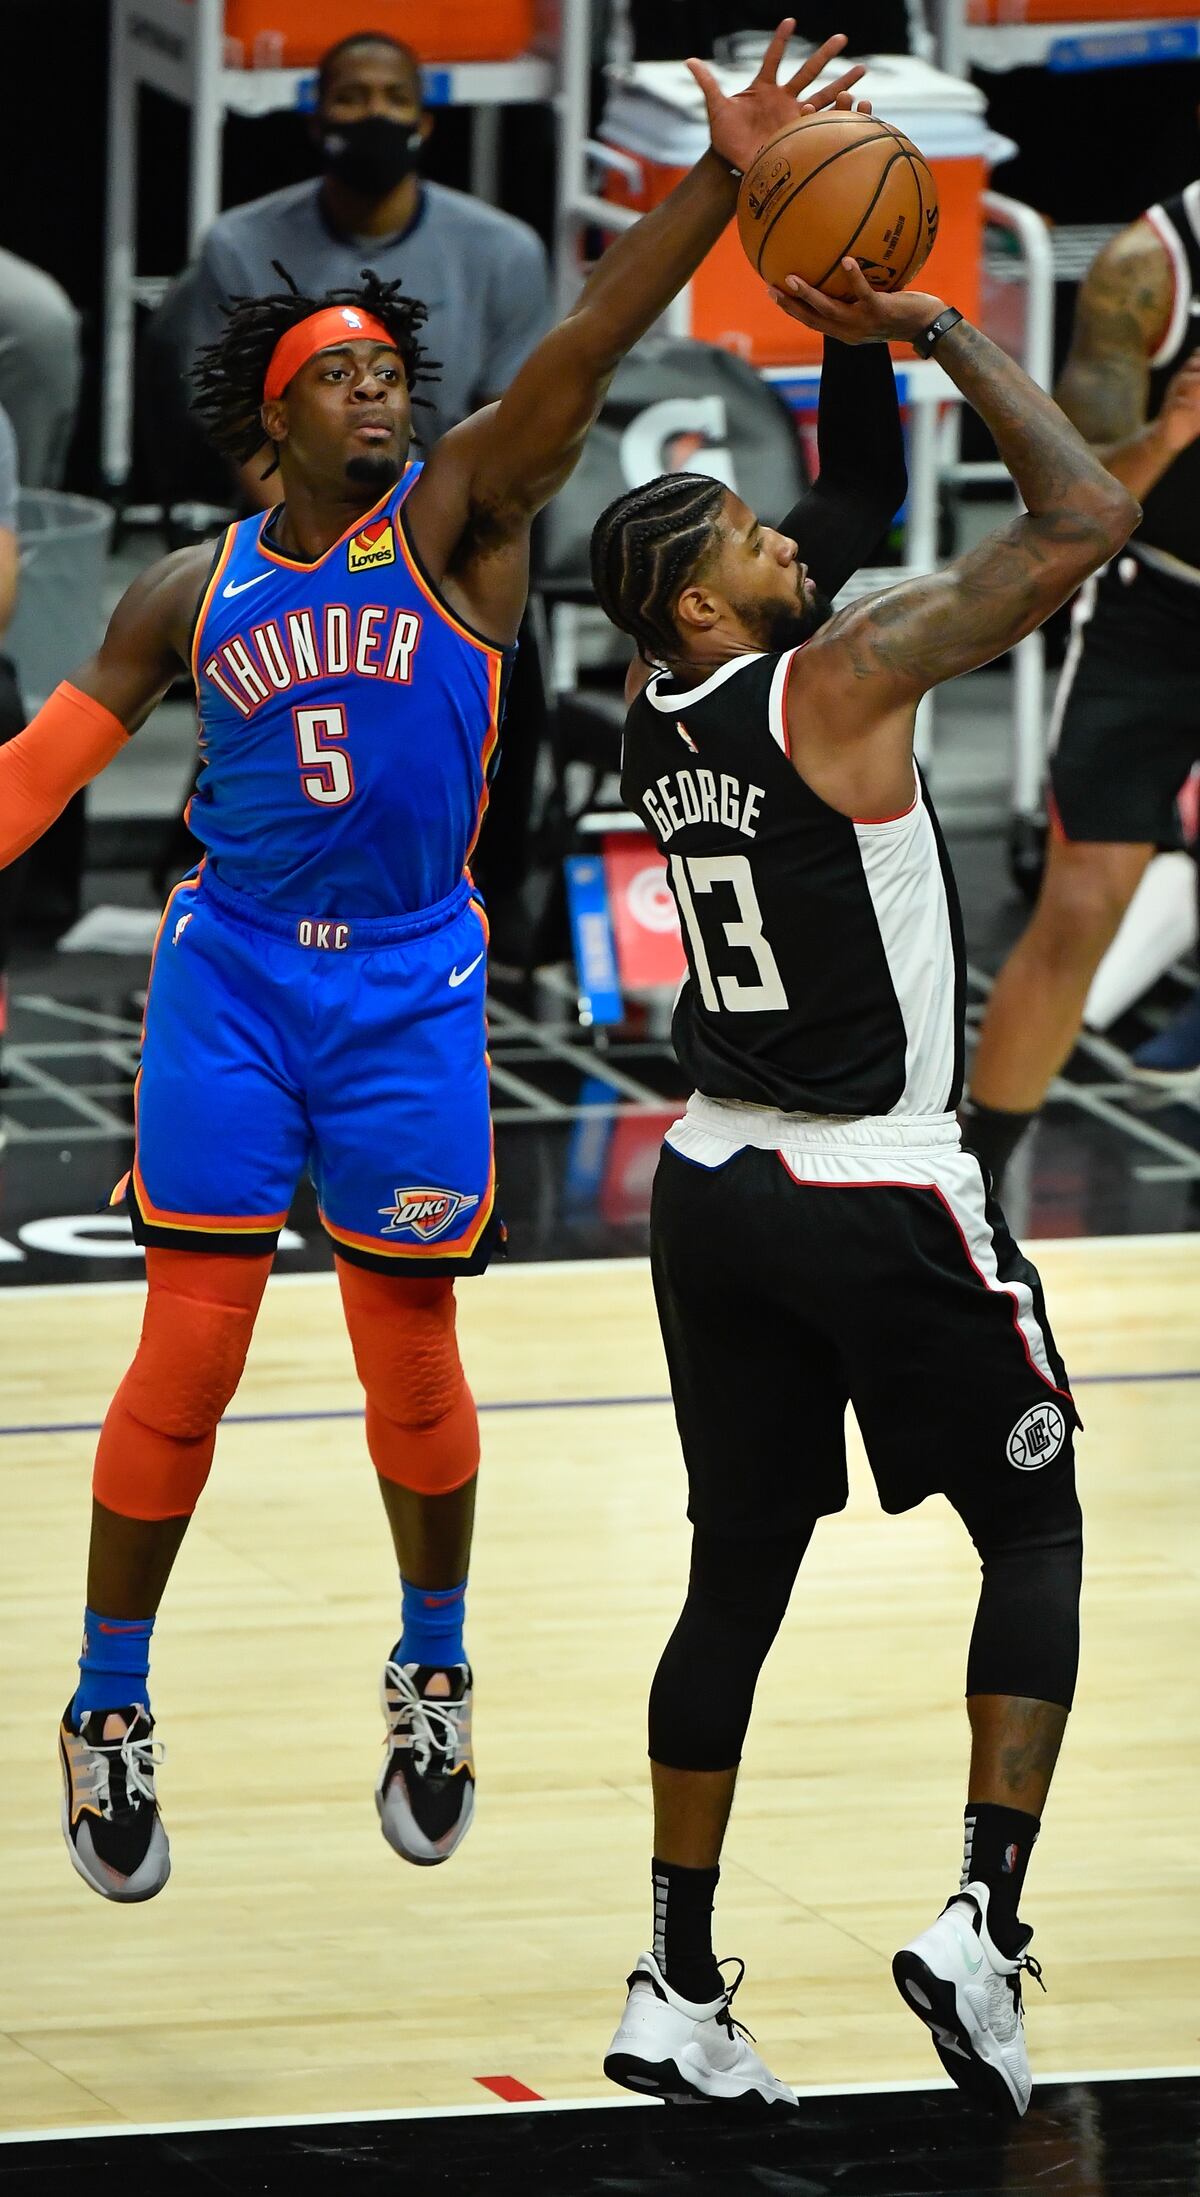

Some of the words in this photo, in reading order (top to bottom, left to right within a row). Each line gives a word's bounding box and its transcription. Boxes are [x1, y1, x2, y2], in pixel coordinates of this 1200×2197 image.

[204, 604, 423, 719] THUNDER
[292, 704, 355, 807] 5
[642, 769, 766, 842] GEORGE
[299, 920, 349, 950] OKC
[670, 854, 790, 1012] 13
[396, 1200, 446, 1224] OKC
